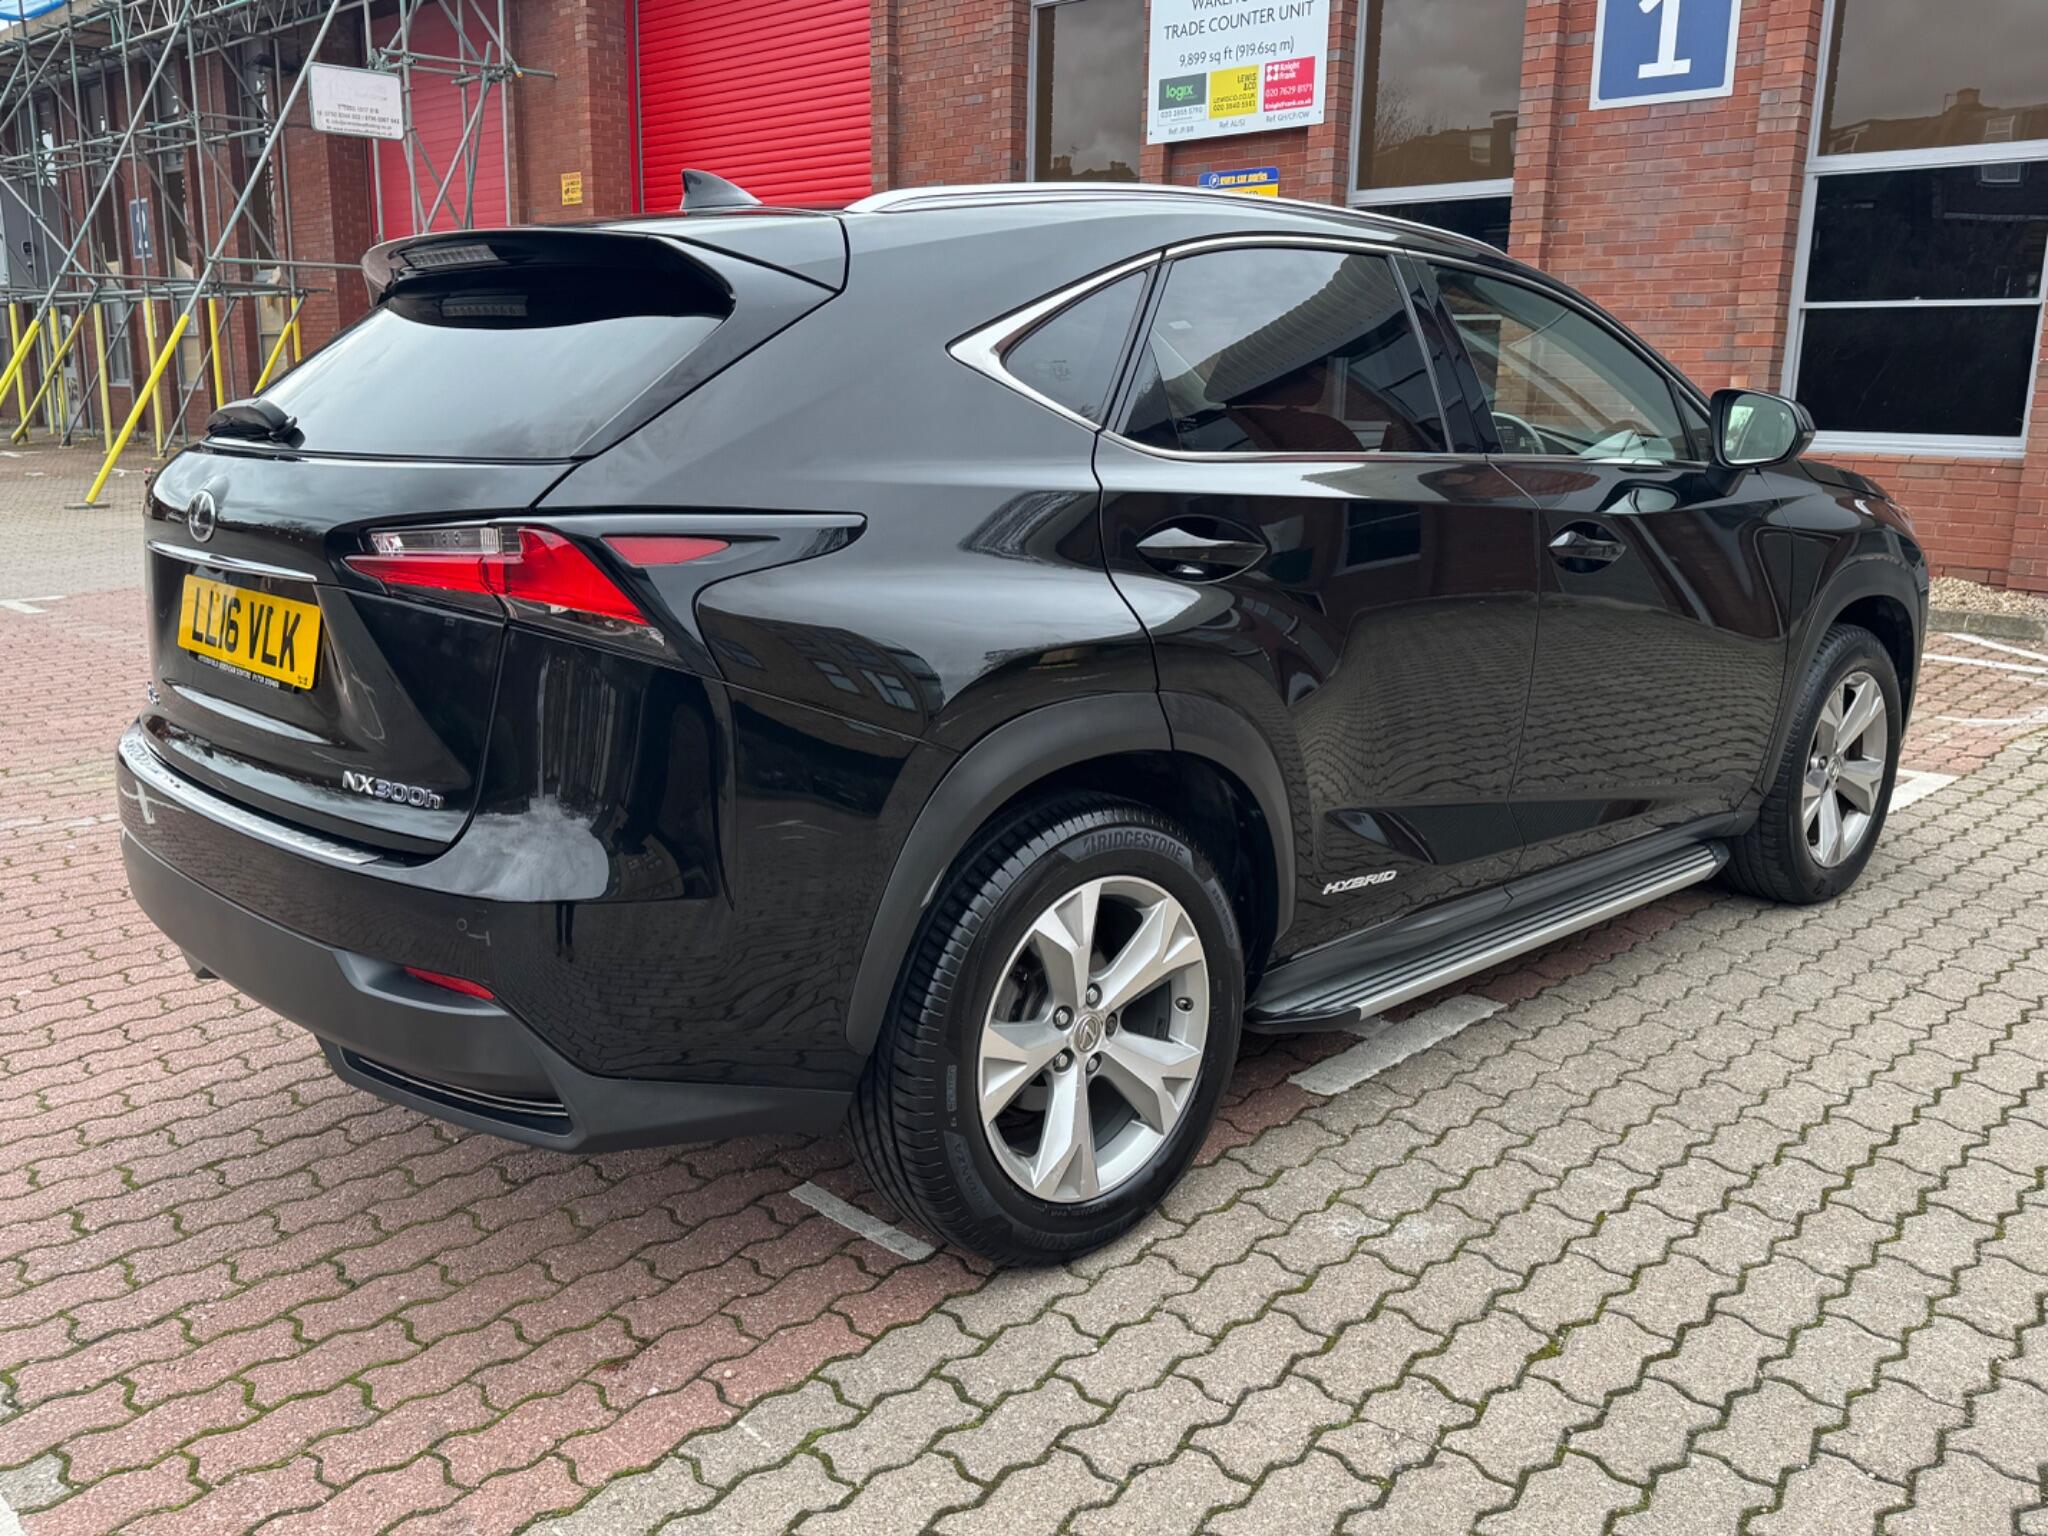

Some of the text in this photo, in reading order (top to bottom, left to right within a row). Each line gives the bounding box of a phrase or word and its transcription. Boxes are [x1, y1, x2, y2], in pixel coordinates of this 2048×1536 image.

[1164, 20, 1206, 40] TRADE
[1208, 8, 1276, 33] COUNTER
[1278, 1, 1314, 21] UNIT
[1179, 52, 1207, 67] 9,899
[1209, 50, 1222, 65] sq
[1224, 47, 1233, 61] ft
[1279, 35, 1295, 54] m)
[1638, 0, 1691, 79] 1
[192, 587, 242, 653] LL16
[249, 601, 301, 672] VLK
[1083, 829, 1186, 863] BRIDGESTONE
[1321, 869, 1398, 896] HYBRID
